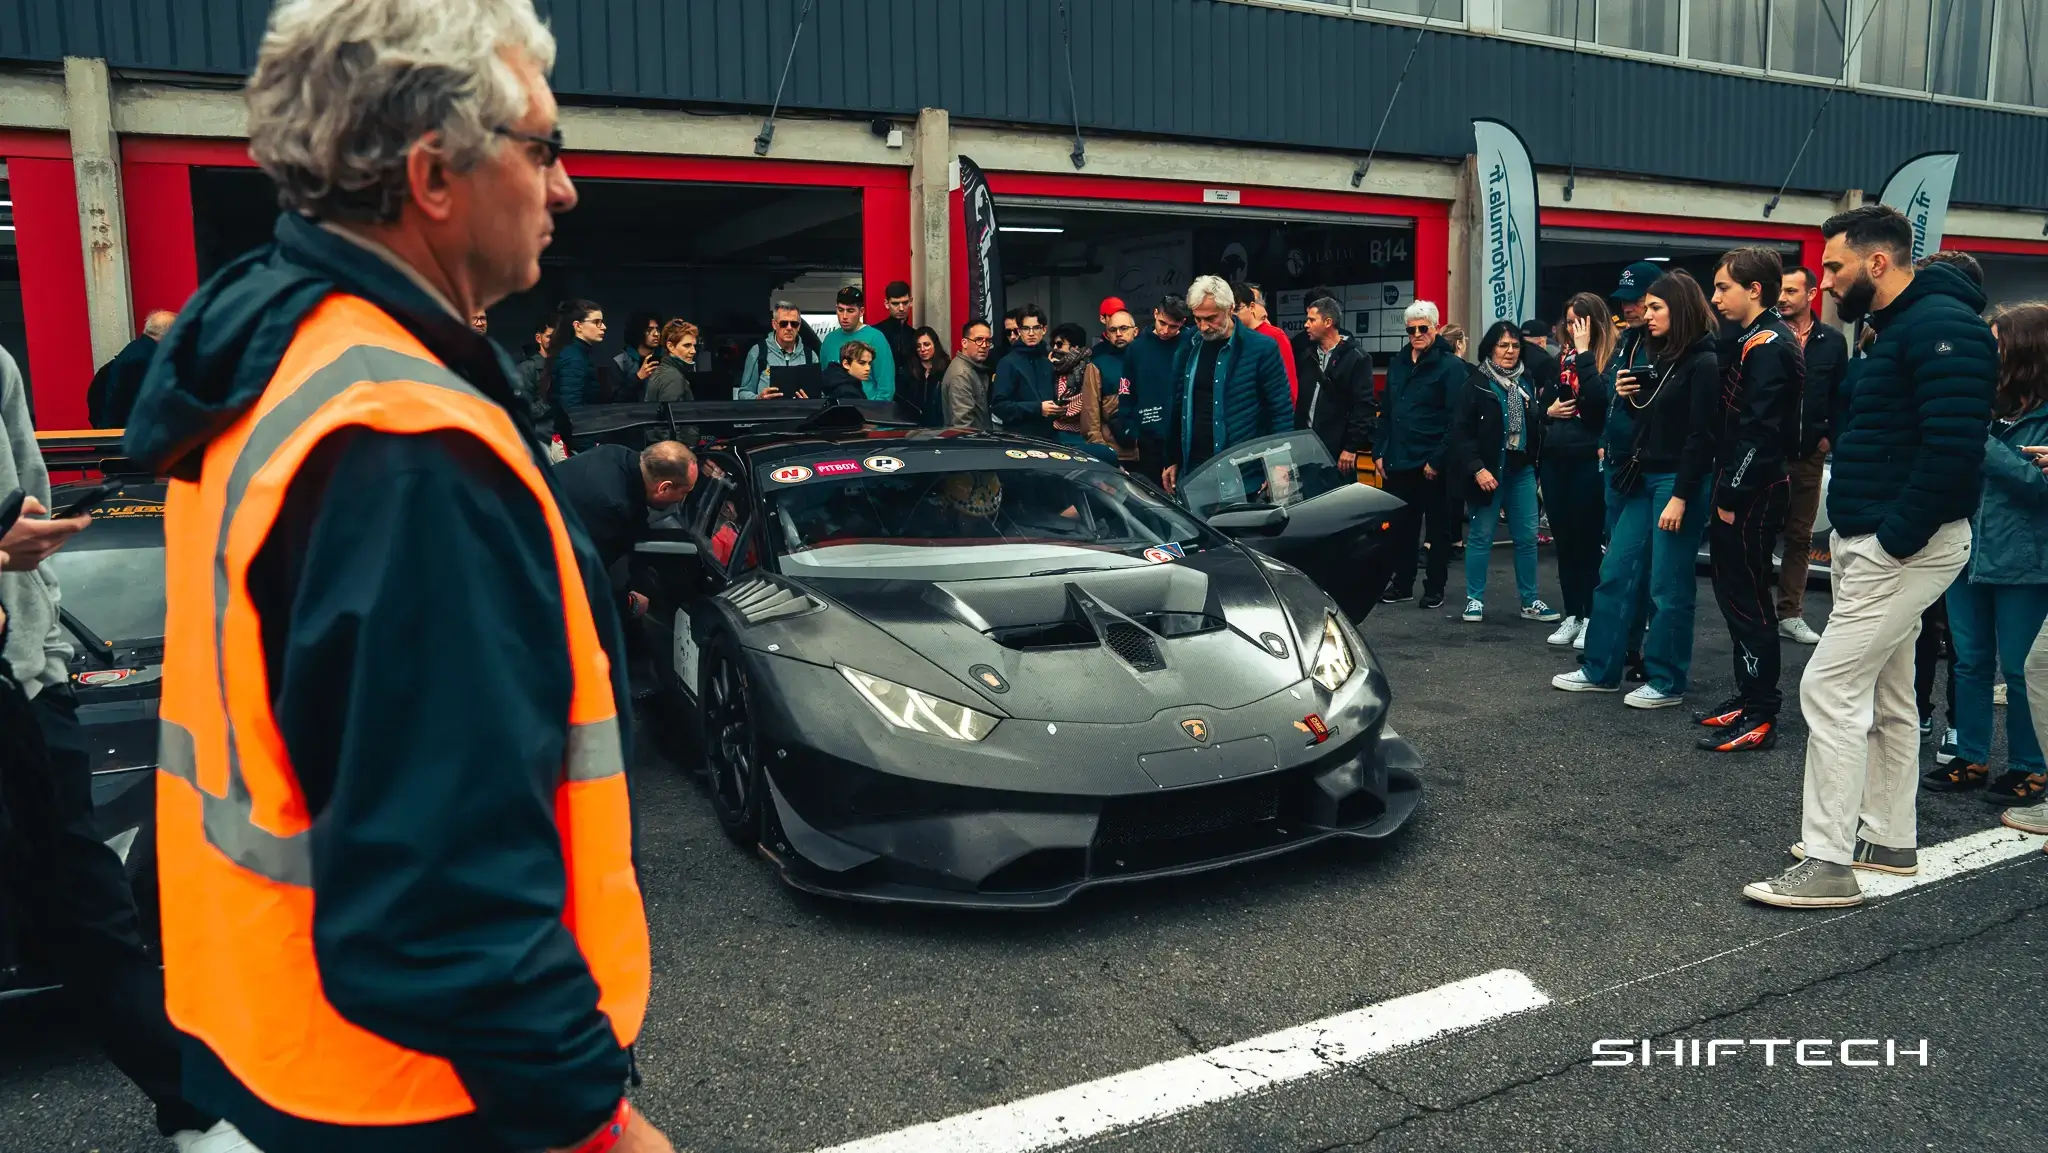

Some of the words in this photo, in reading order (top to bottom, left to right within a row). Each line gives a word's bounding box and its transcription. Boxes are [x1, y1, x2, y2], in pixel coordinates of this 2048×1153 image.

[1911, 191, 1931, 261] mula.fr
[1369, 238, 1408, 264] B14
[818, 462, 858, 473] PITBOX
